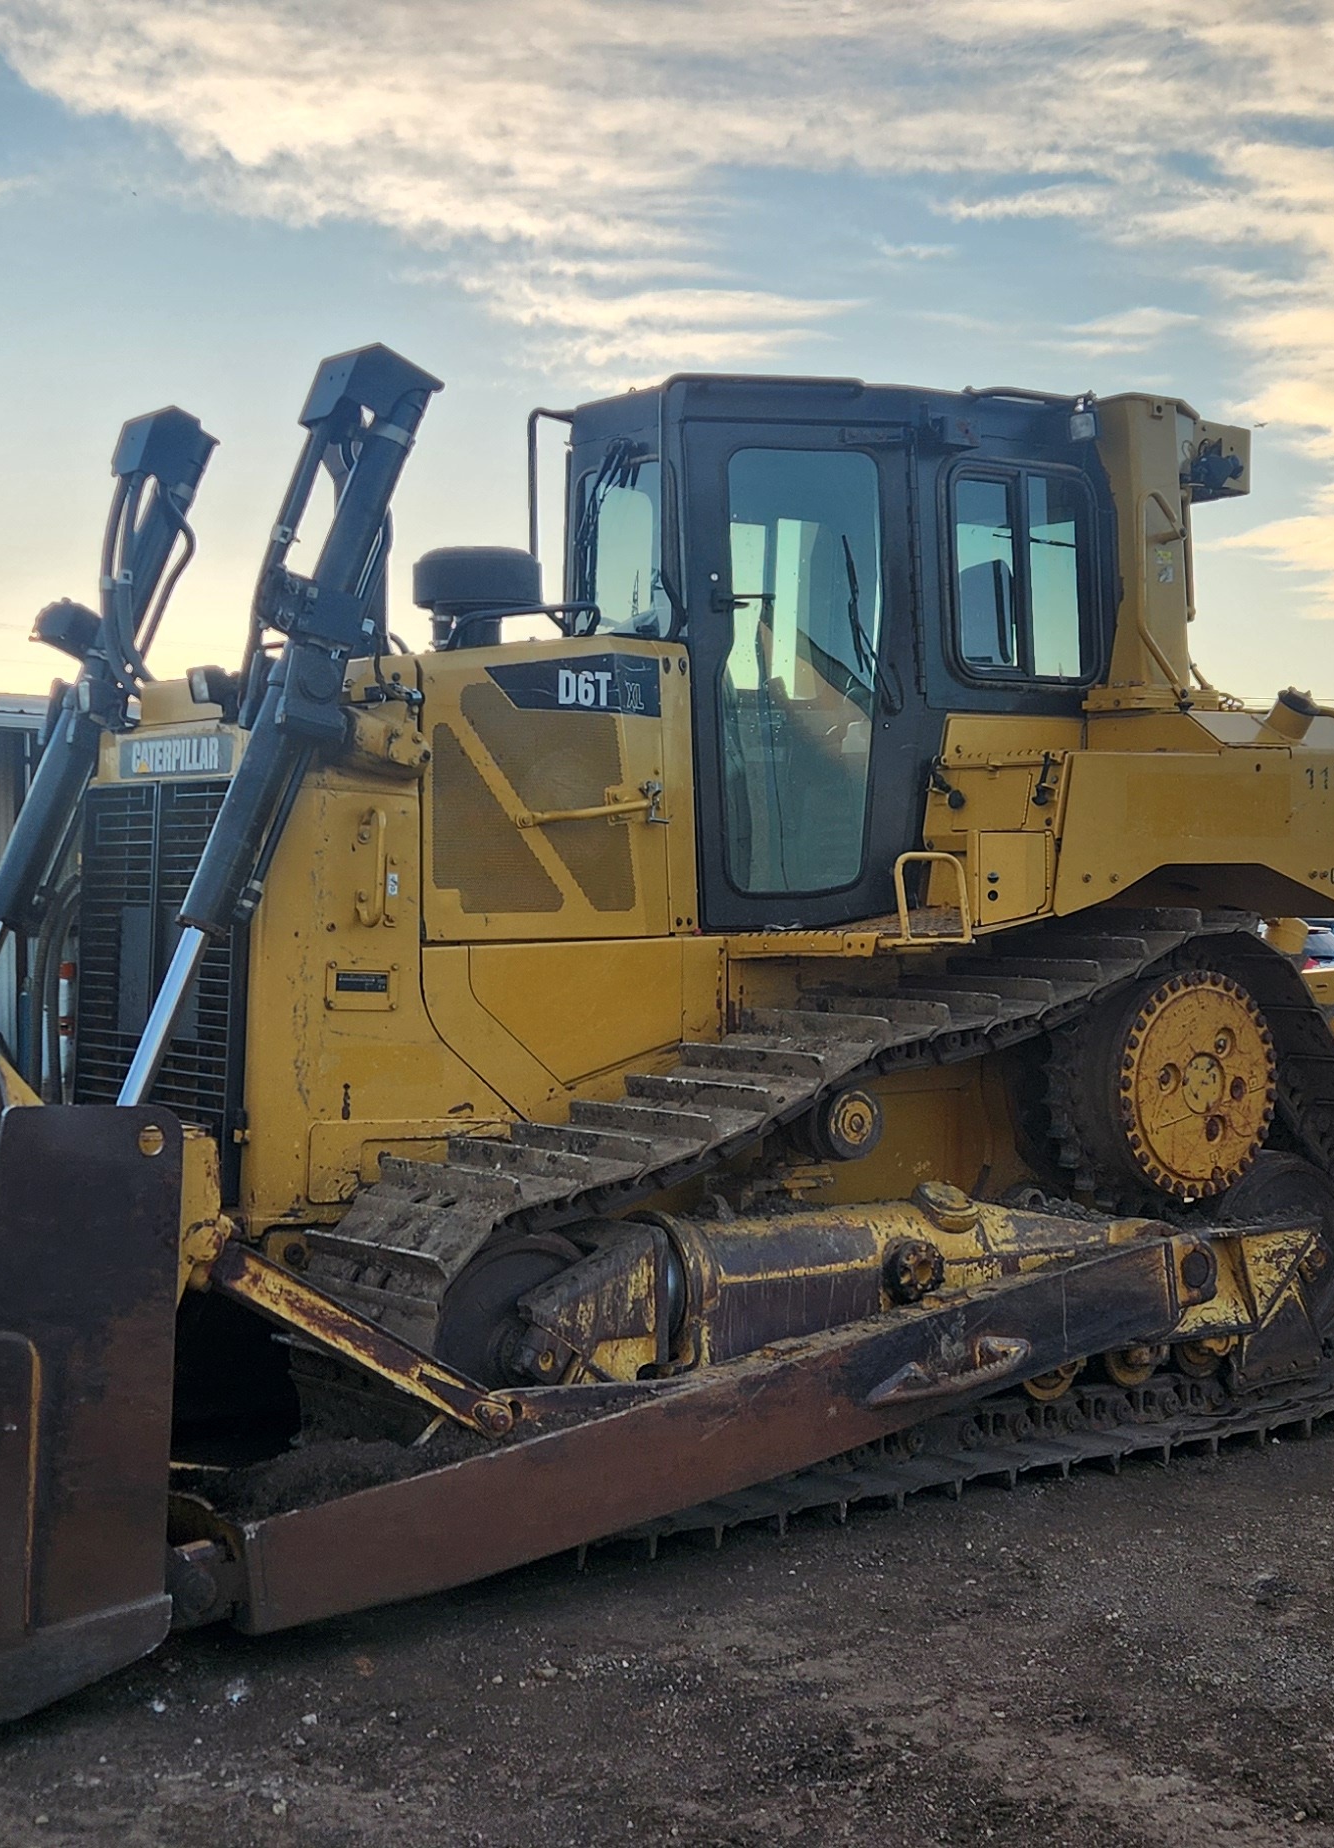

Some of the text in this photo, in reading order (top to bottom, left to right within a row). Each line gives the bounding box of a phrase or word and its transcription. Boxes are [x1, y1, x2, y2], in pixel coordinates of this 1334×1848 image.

[558, 669, 645, 711] D6T XL
[131, 737, 219, 773] CATERPILLAR
